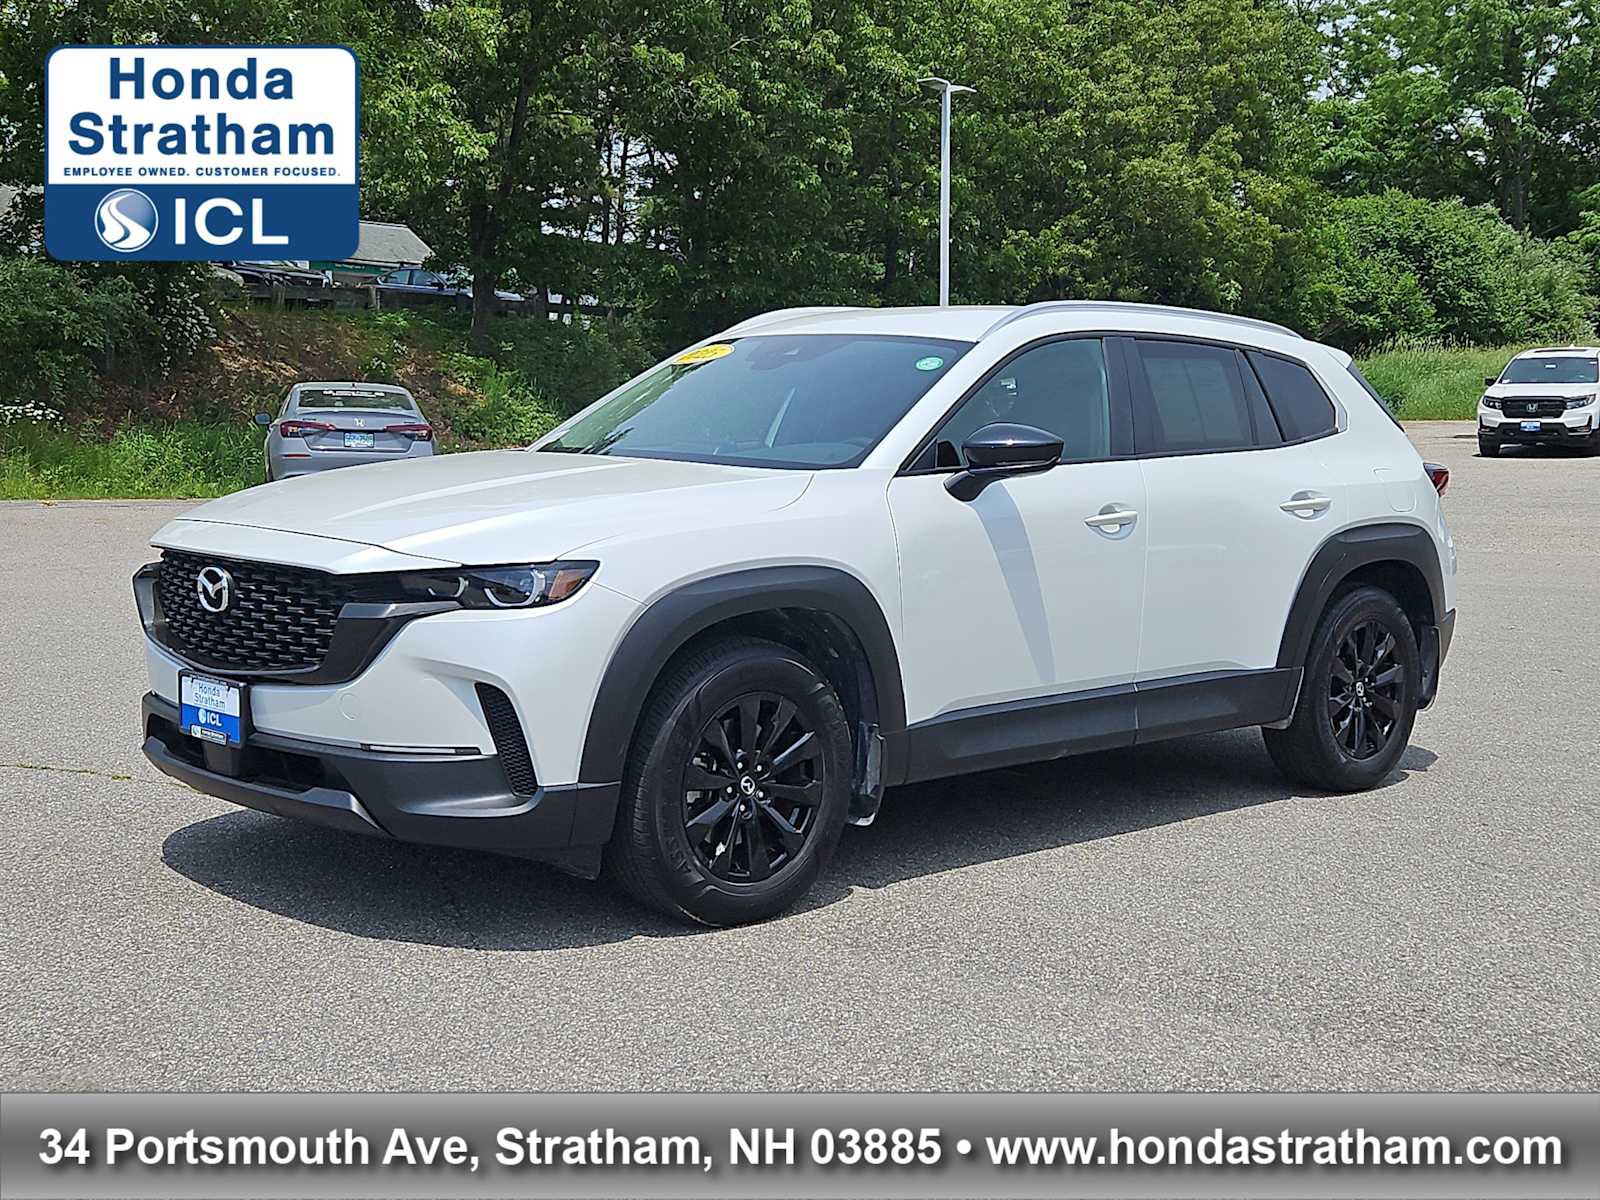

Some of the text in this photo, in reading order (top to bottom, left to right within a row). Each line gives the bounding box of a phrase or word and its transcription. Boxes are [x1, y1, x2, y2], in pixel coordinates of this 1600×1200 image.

[198, 682, 221, 697] Honda
[194, 693, 226, 708] Stratham
[206, 712, 222, 727] ICL
